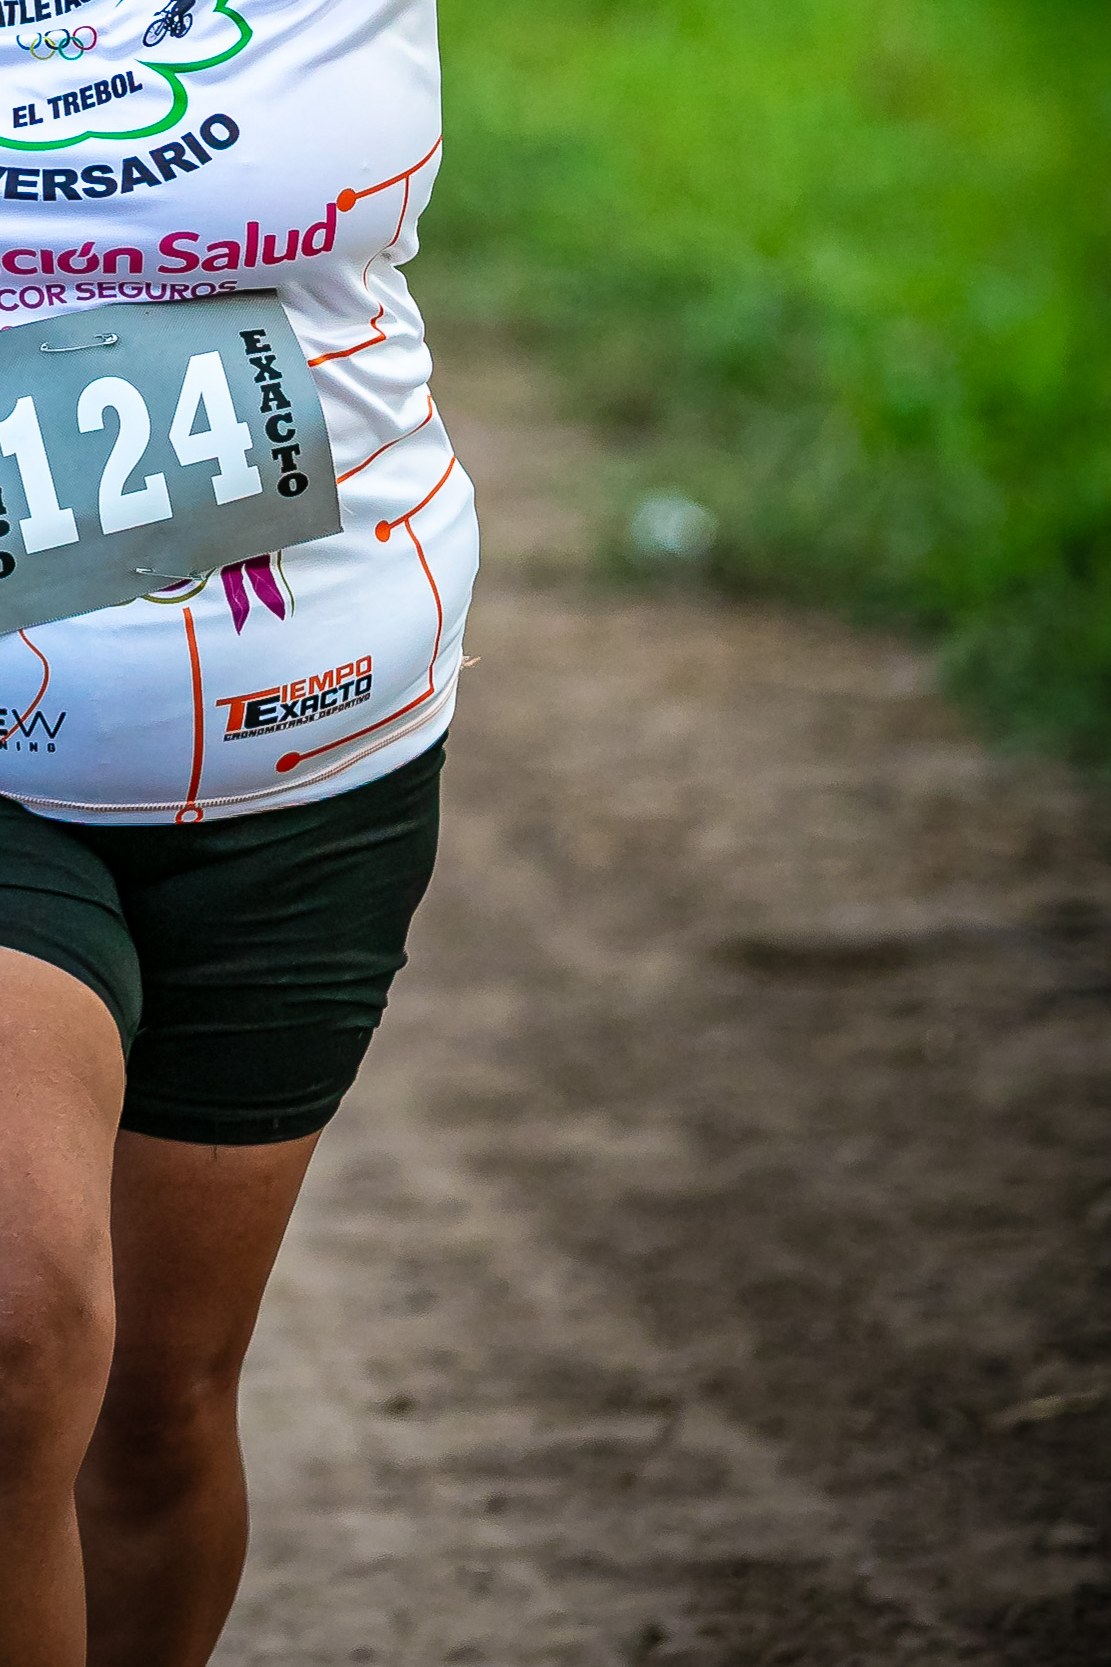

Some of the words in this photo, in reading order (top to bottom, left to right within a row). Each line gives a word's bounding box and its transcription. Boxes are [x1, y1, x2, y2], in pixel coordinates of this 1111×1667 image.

[12, 104, 44, 128] EL
[46, 70, 143, 119] TREBOL
[158, 202, 338, 275] Salud
[74, 281, 237, 301] SEGUROS
[238, 328, 309, 498] EXACTO
[215, 654, 373, 733] TIEMPO
[244, 673, 373, 730] EXACTO
